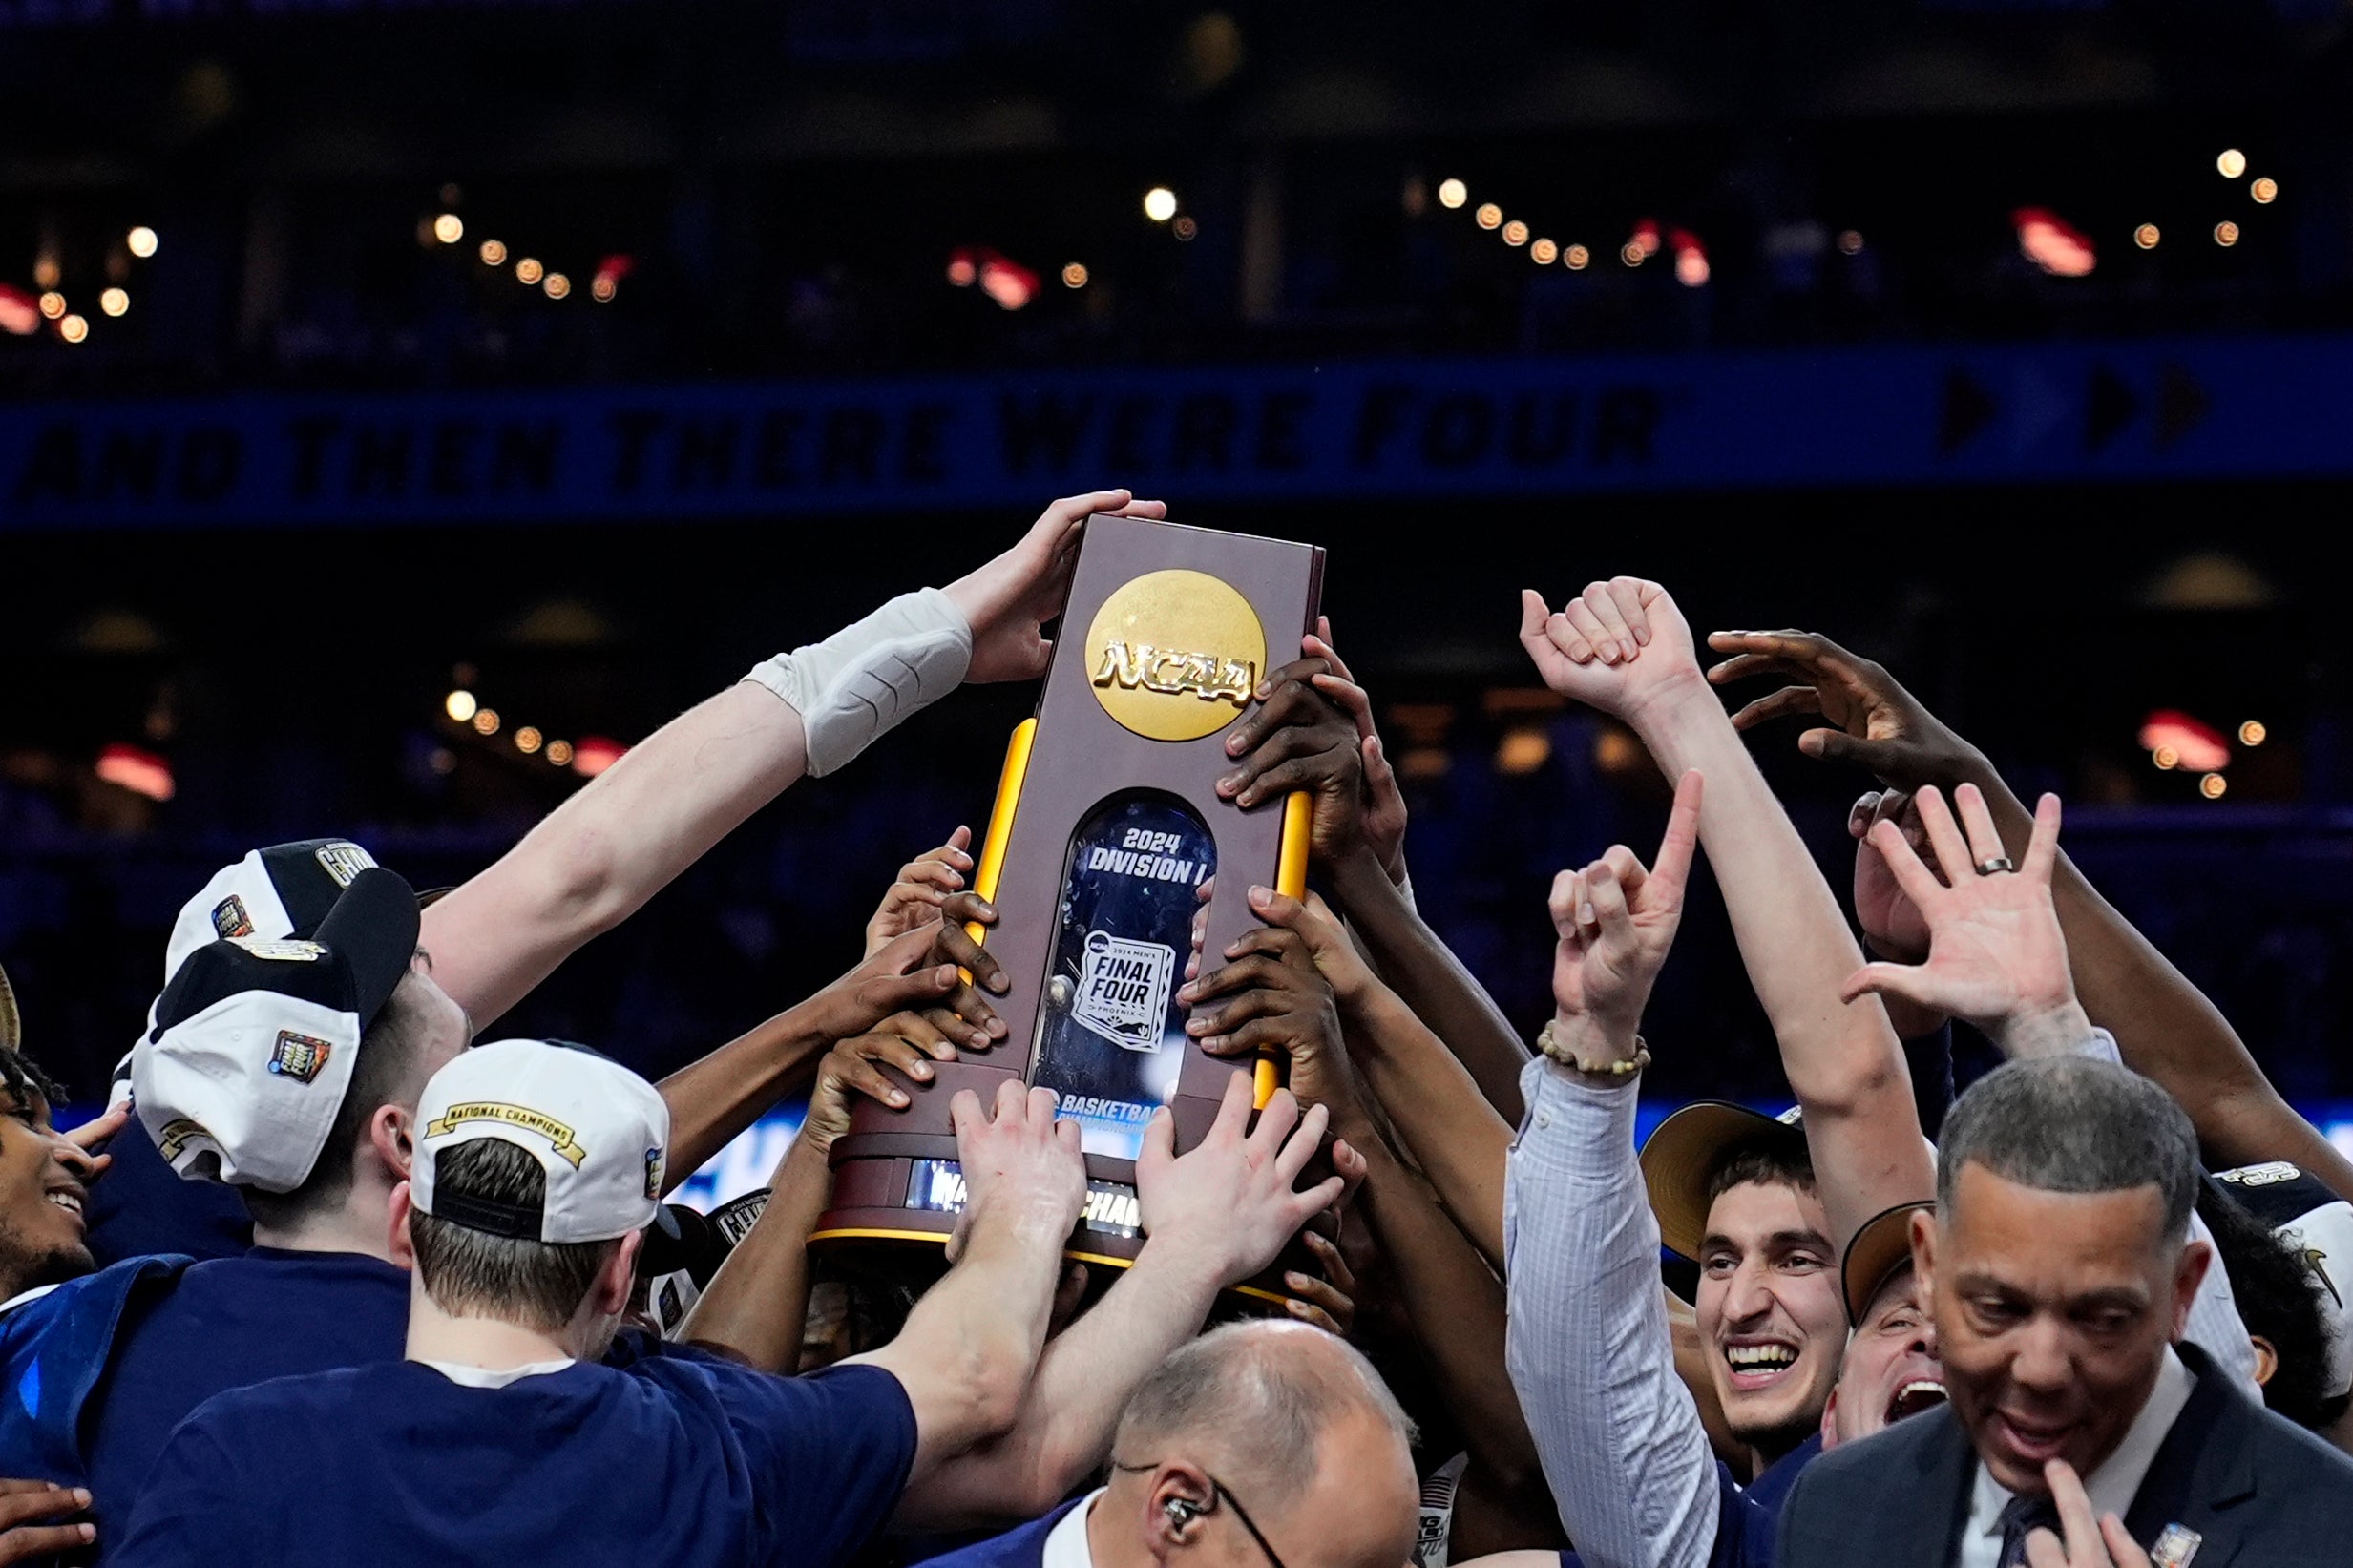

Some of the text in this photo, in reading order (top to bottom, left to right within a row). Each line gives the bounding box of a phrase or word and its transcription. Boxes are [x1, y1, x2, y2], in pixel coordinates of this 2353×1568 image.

[13, 378, 1665, 500] AND THEN THERE WERE FOUR
[1094, 640, 1255, 709] NCAA
[1123, 827, 1182, 855] 2024
[1088, 847, 1208, 886] DIVISION I
[1094, 956, 1152, 984] FINAL
[1090, 977, 1149, 1005] FOUR
[1098, 1005, 1136, 1017] PHOENIX
[289, 1041, 309, 1076] FOUR
[450, 1105, 568, 1140] NATIONAL CHAMPIONS
[1061, 1094, 1158, 1123] BASKETBA
